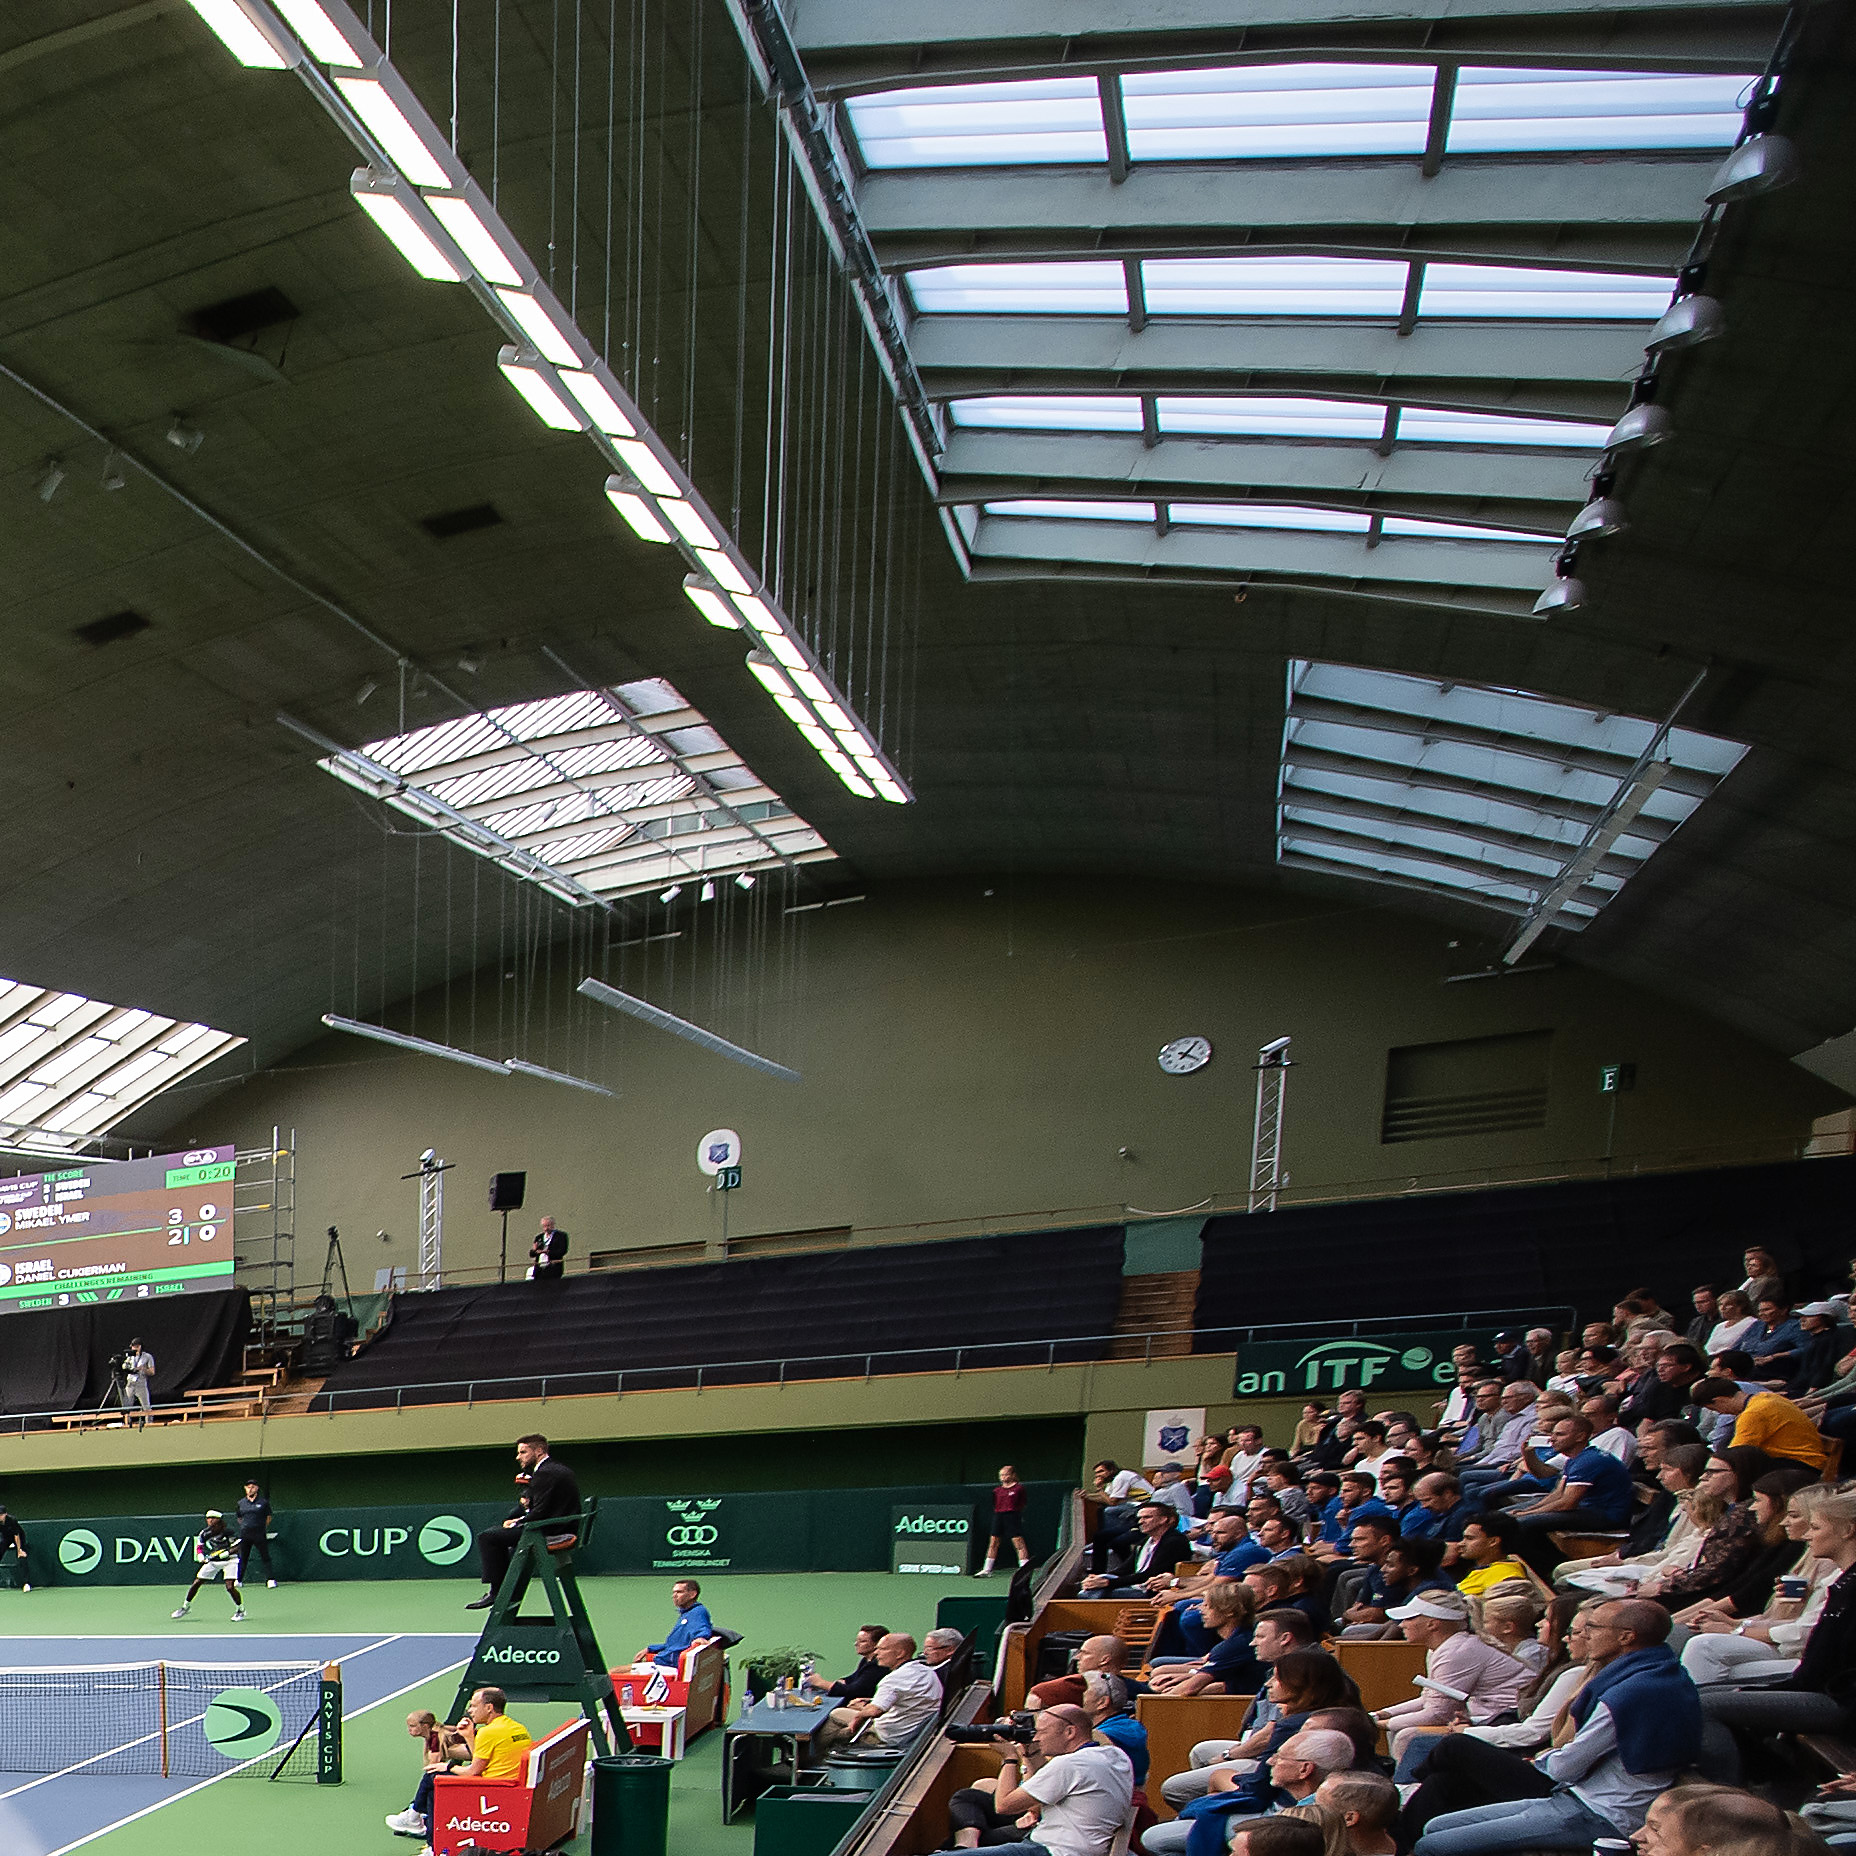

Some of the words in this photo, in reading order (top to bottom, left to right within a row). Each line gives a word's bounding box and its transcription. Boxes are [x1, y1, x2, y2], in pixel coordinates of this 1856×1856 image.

[199, 1167, 231, 1181] 0:20
[14, 1203, 64, 1220] SWEDEN
[168, 1208, 183, 1225] 3
[199, 1204, 217, 1221] 0
[15, 1217, 56, 1231] MIKAEL
[58, 1212, 91, 1225] YMER
[168, 1228, 182, 1246] 2
[199, 1225, 217, 1241] 0
[14, 1259, 55, 1275] ISRAEL
[15, 1271, 56, 1285] DANIEL
[57, 1263, 126, 1279] CUKIERMAN
[58, 1293, 70, 1306] 3
[137, 1285, 149, 1298] 2
[1238, 1370, 1286, 1393] an
[1305, 1356, 1391, 1391] ITF
[894, 1514, 969, 1533] Adecco
[115, 1536, 223, 1563] DAVI
[319, 1527, 409, 1557] CUP
[481, 1645, 560, 1664] Adecco
[323, 1691, 334, 1740] DAVIS
[323, 1745, 333, 1774] CUP
[446, 1816, 511, 1833] Adecco
